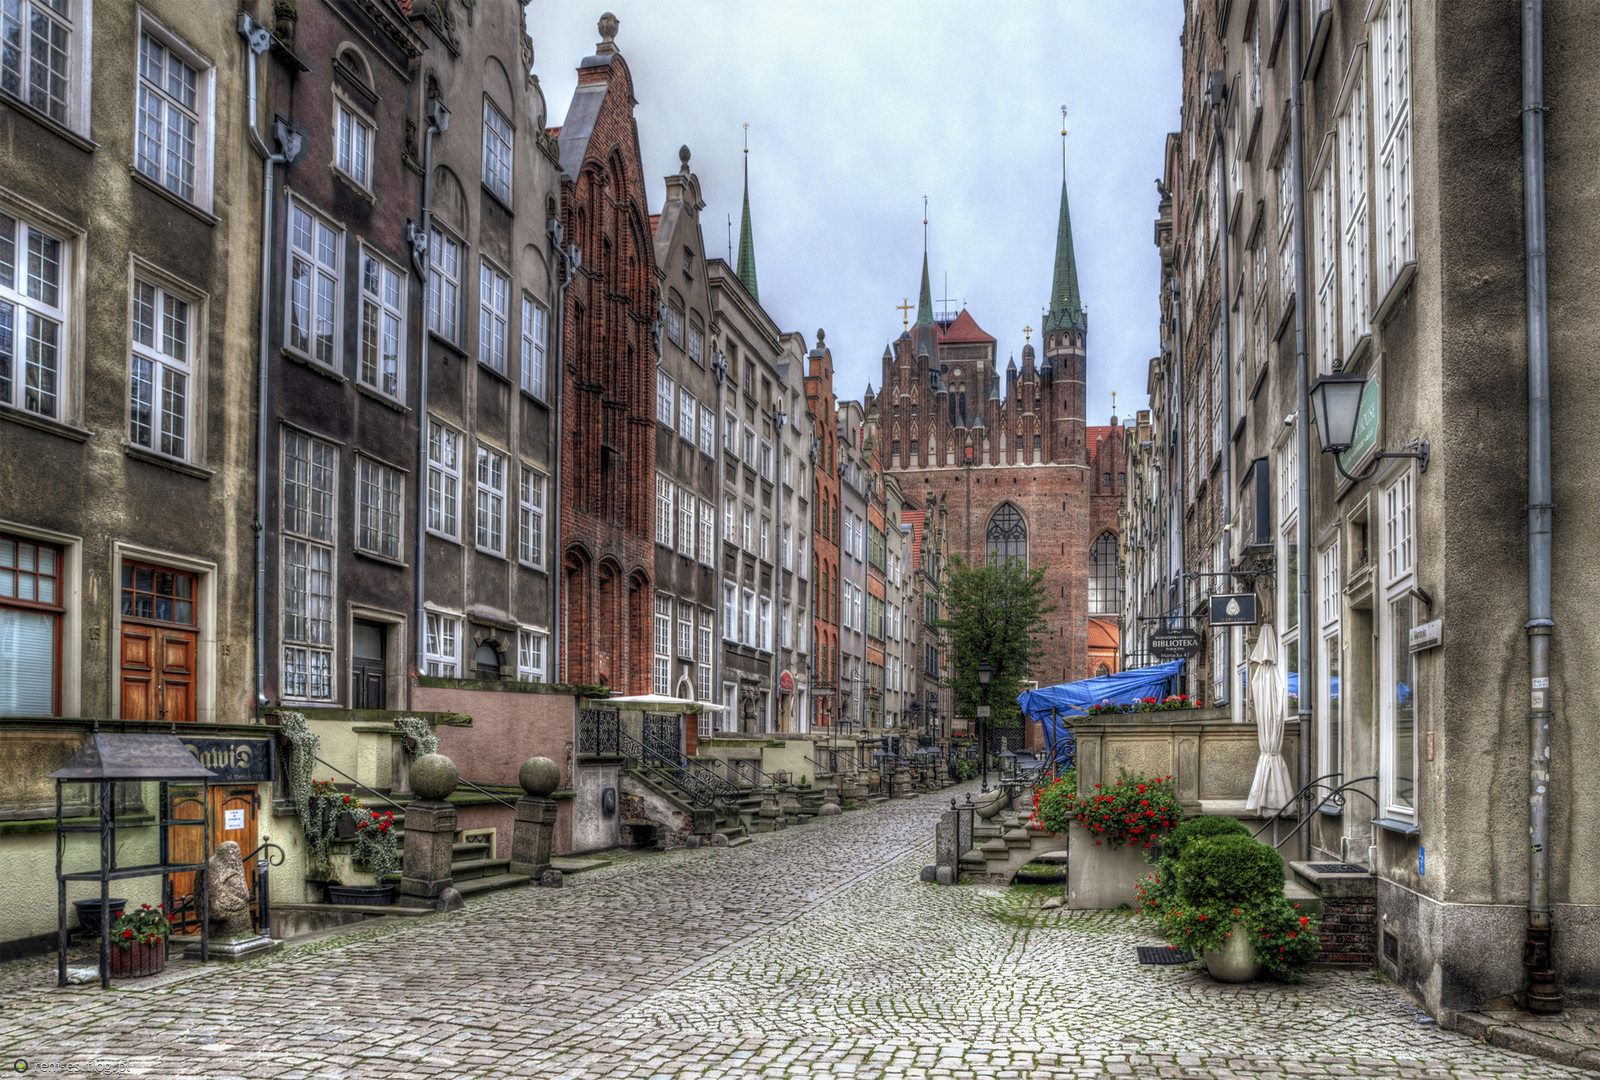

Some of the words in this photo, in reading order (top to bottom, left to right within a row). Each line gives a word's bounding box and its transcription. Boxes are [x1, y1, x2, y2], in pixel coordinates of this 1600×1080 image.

[89, 625, 101, 641] 15
[1152, 639, 1198, 647] BIBLIOTEKA
[221, 644, 231, 656] 15
